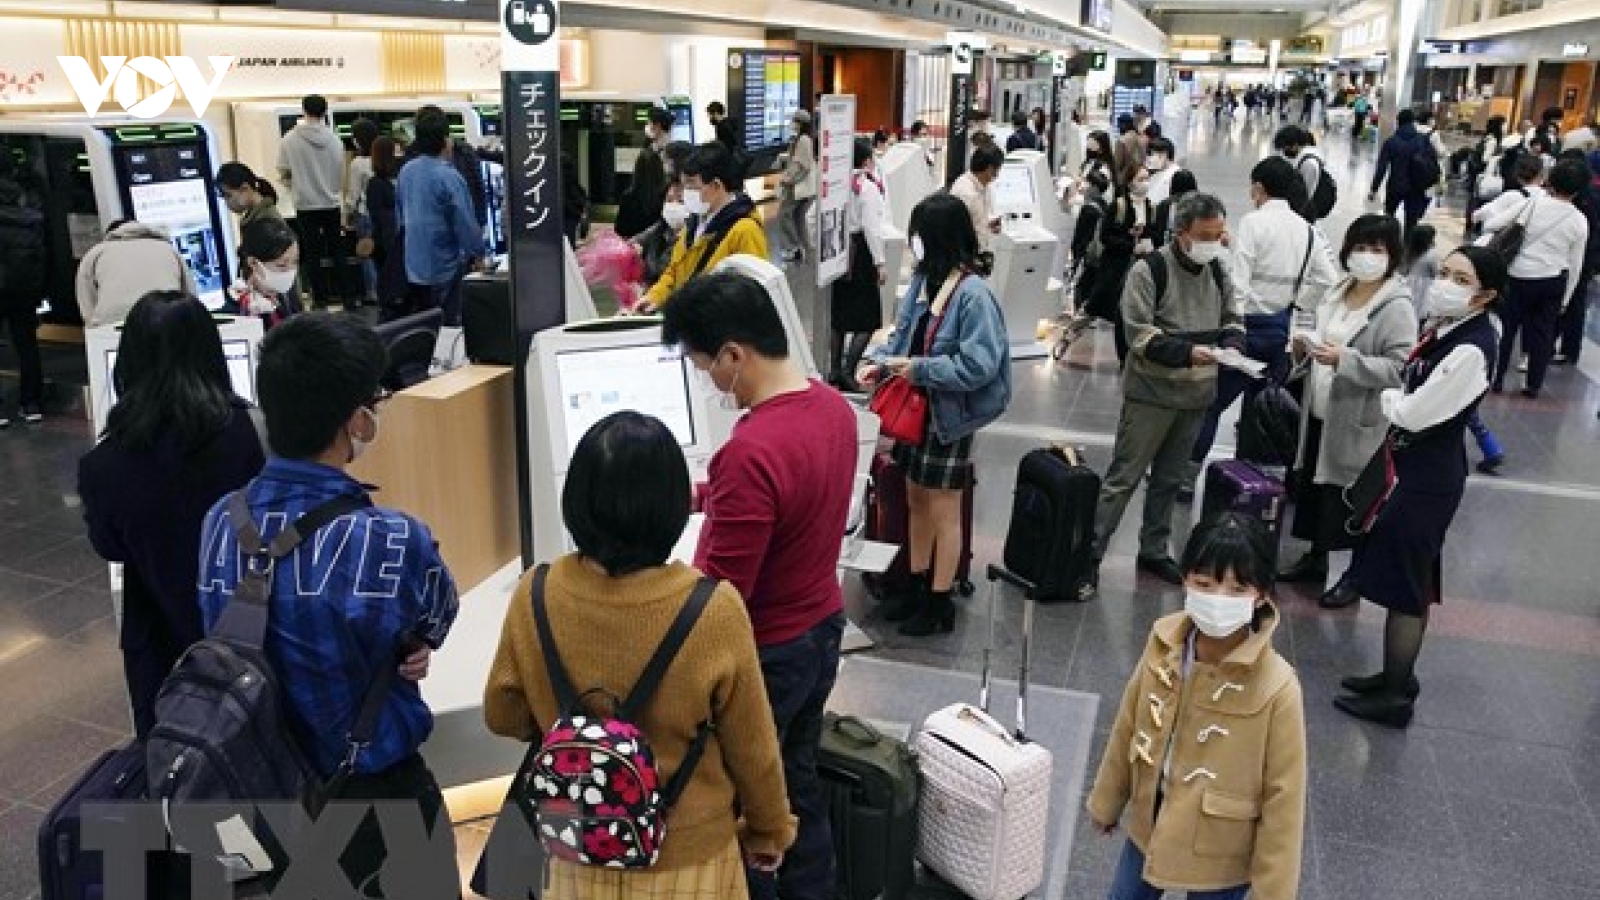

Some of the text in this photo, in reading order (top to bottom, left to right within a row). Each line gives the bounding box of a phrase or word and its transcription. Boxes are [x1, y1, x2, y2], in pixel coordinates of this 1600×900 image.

[519, 82, 550, 230] チェックイン
